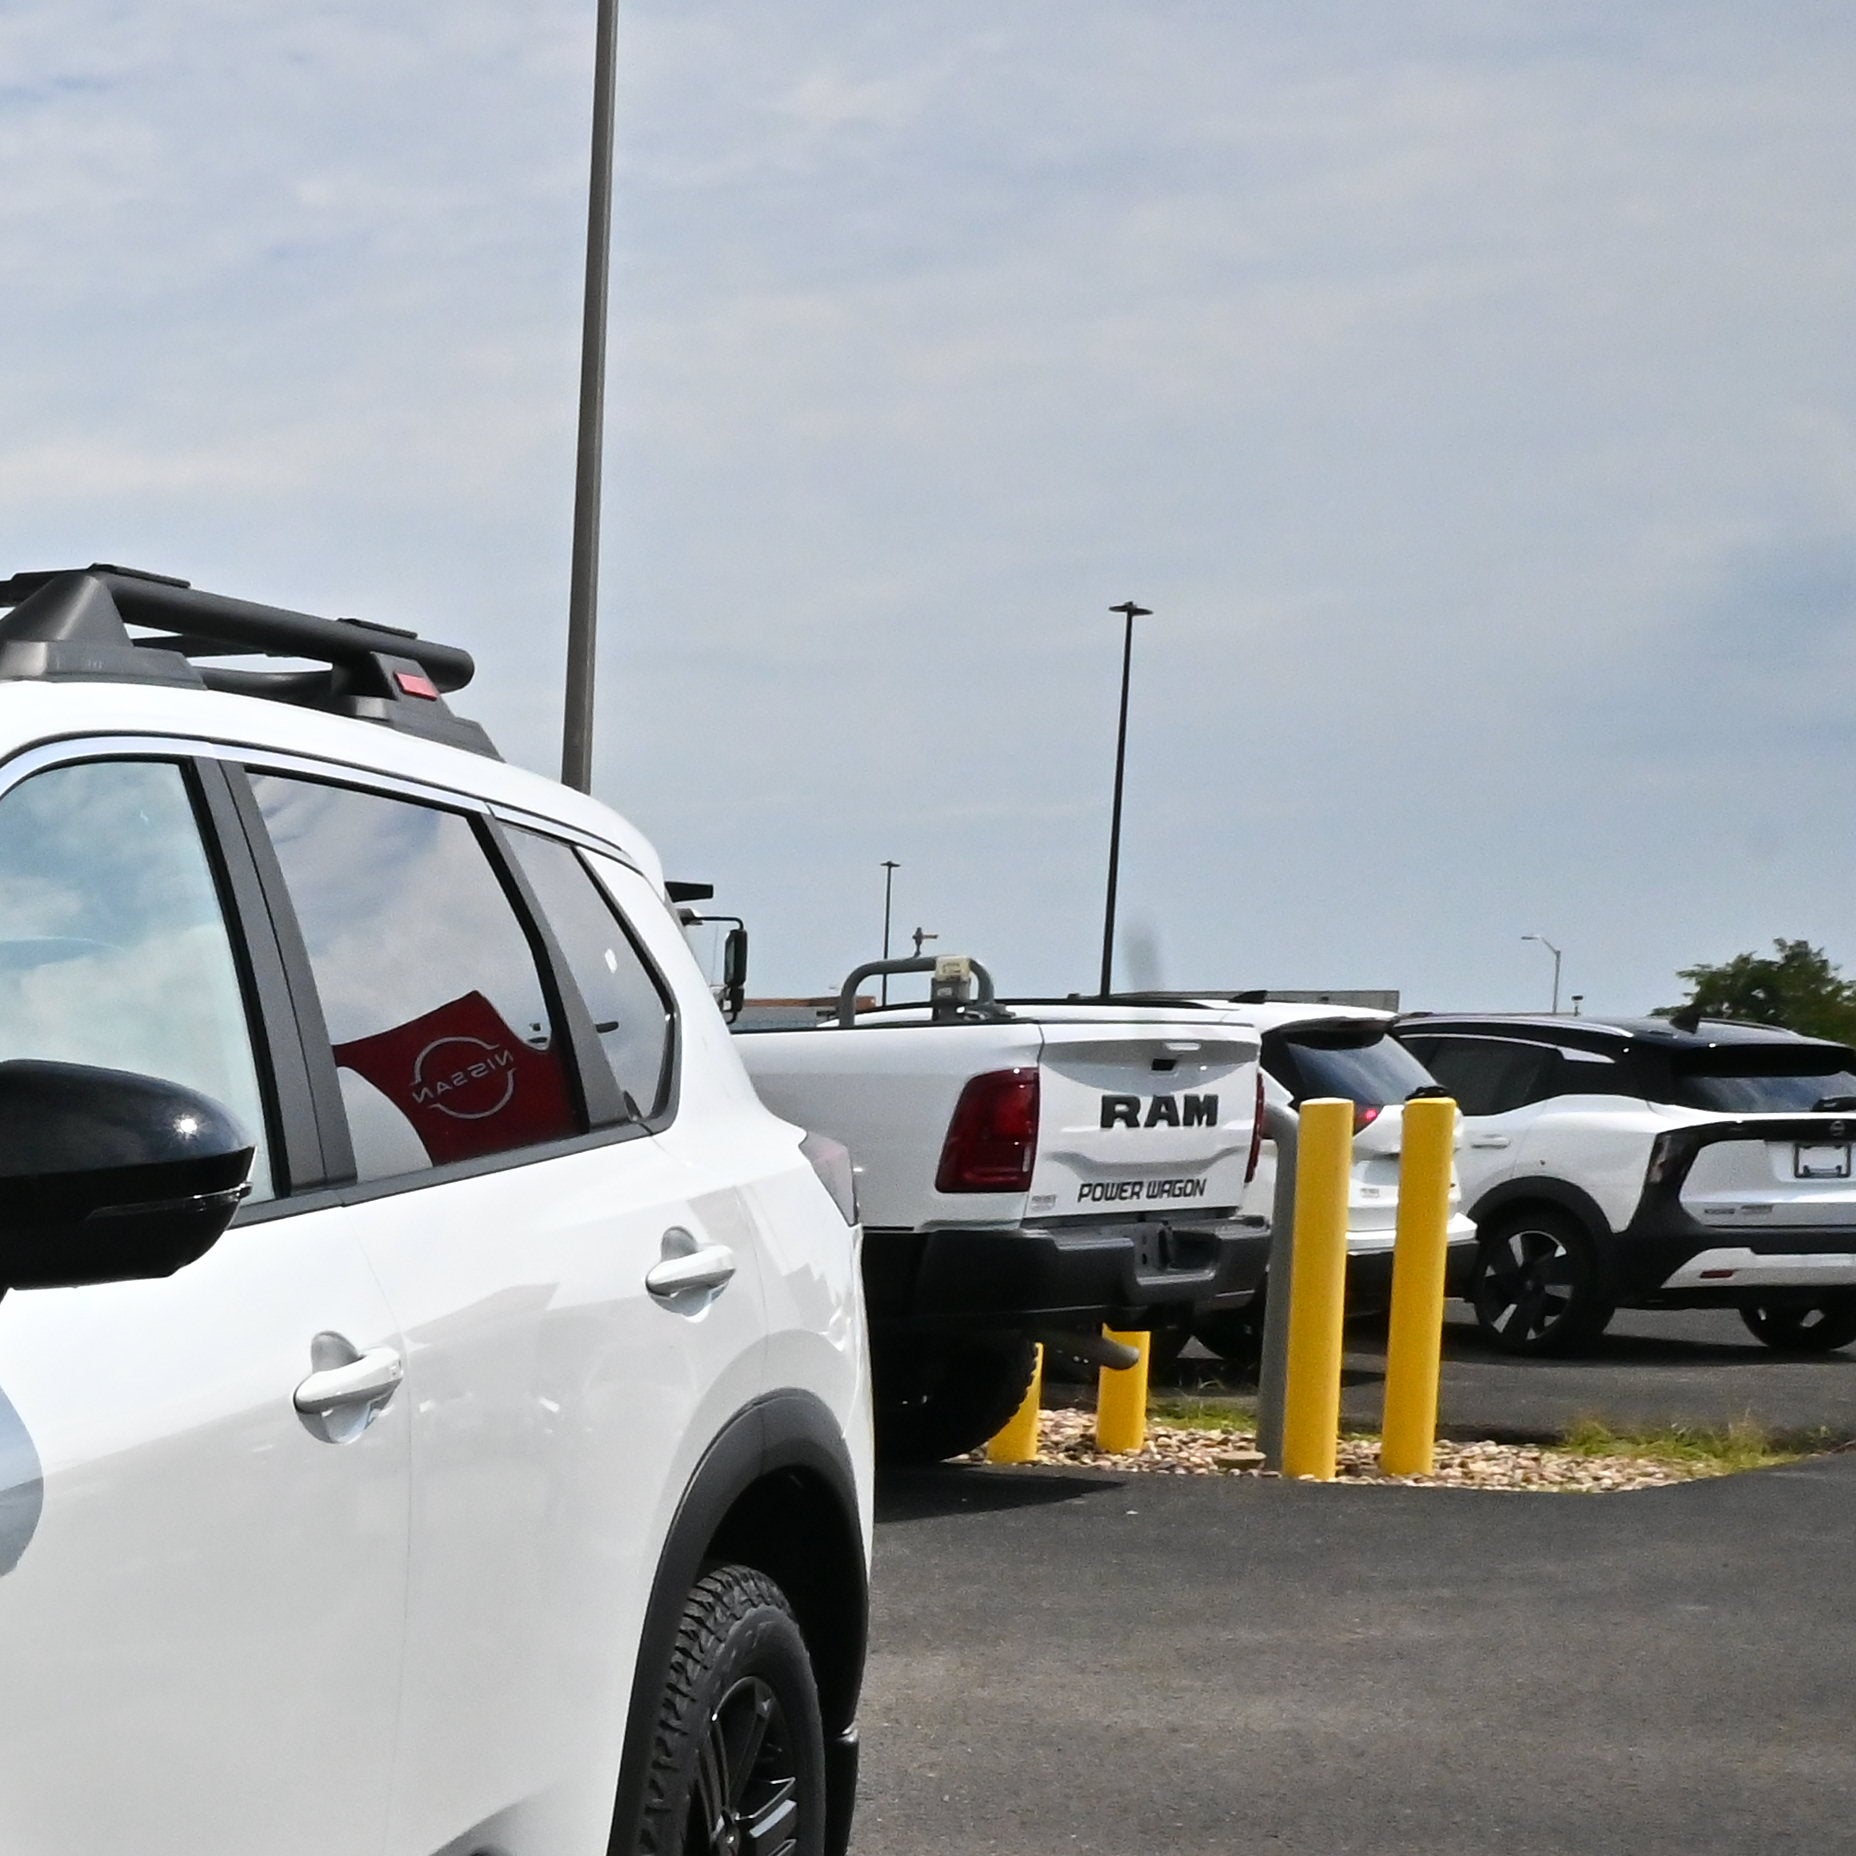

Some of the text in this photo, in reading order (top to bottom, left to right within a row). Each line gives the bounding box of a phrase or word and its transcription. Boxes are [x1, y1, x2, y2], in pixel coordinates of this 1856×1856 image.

[1100, 1094, 1219, 1129] RAM
[1076, 1180, 1144, 1203] POWER
[1145, 1178, 1208, 1200] WAGON
